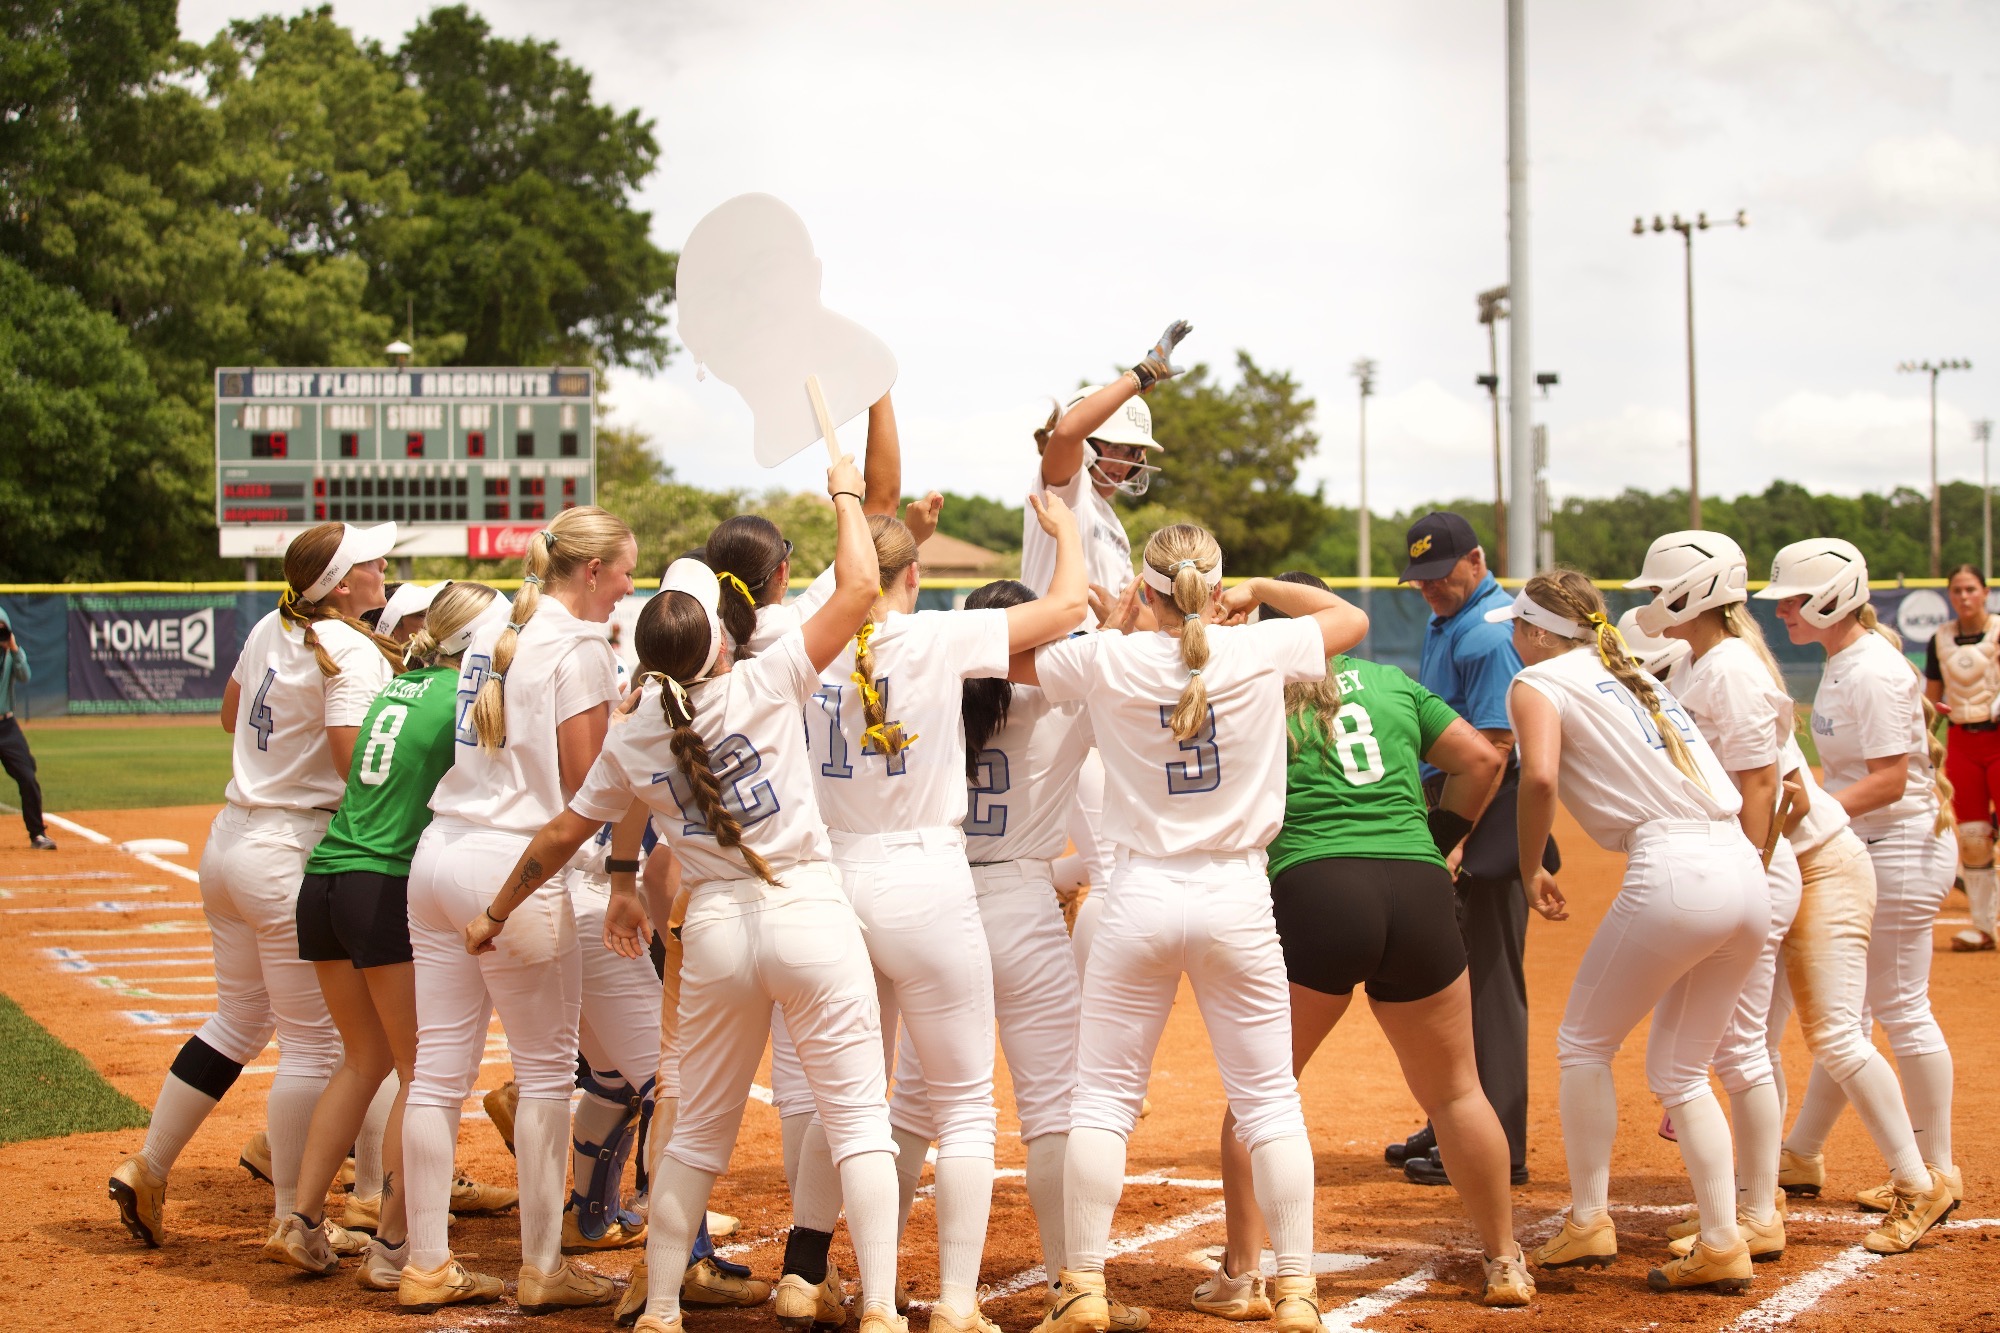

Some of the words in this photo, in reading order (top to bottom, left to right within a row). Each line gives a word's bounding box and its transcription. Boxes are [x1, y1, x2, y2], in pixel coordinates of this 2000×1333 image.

[252, 373, 314, 396] WEST
[318, 373, 411, 396] FLORIDA
[421, 373, 550, 396] ARGONAUTS
[243, 405, 261, 430] AT
[266, 405, 294, 430] BAT
[330, 405, 366, 430] BALL
[387, 404, 442, 430] STRIKE
[460, 405, 491, 430] OUT
[1127, 406, 1150, 434] UWF
[269, 431, 287, 458] 9
[407, 431, 424, 458] 2
[467, 431, 485, 458] 0
[313, 477, 327, 497] 0
[495, 477, 509, 497] 0
[531, 477, 545, 497] 0
[1669, 579, 1687, 594] EASTON
[90, 618, 181, 650] HOME
[1651, 652, 1670, 666] EASTON
[249, 667, 278, 752] 4
[812, 676, 910, 779] 14
[360, 705, 408, 786] 8
[1159, 702, 1221, 795] 3
[1332, 702, 1386, 786] 8
[652, 733, 780, 836] 12
[960, 748, 1010, 836] 2
